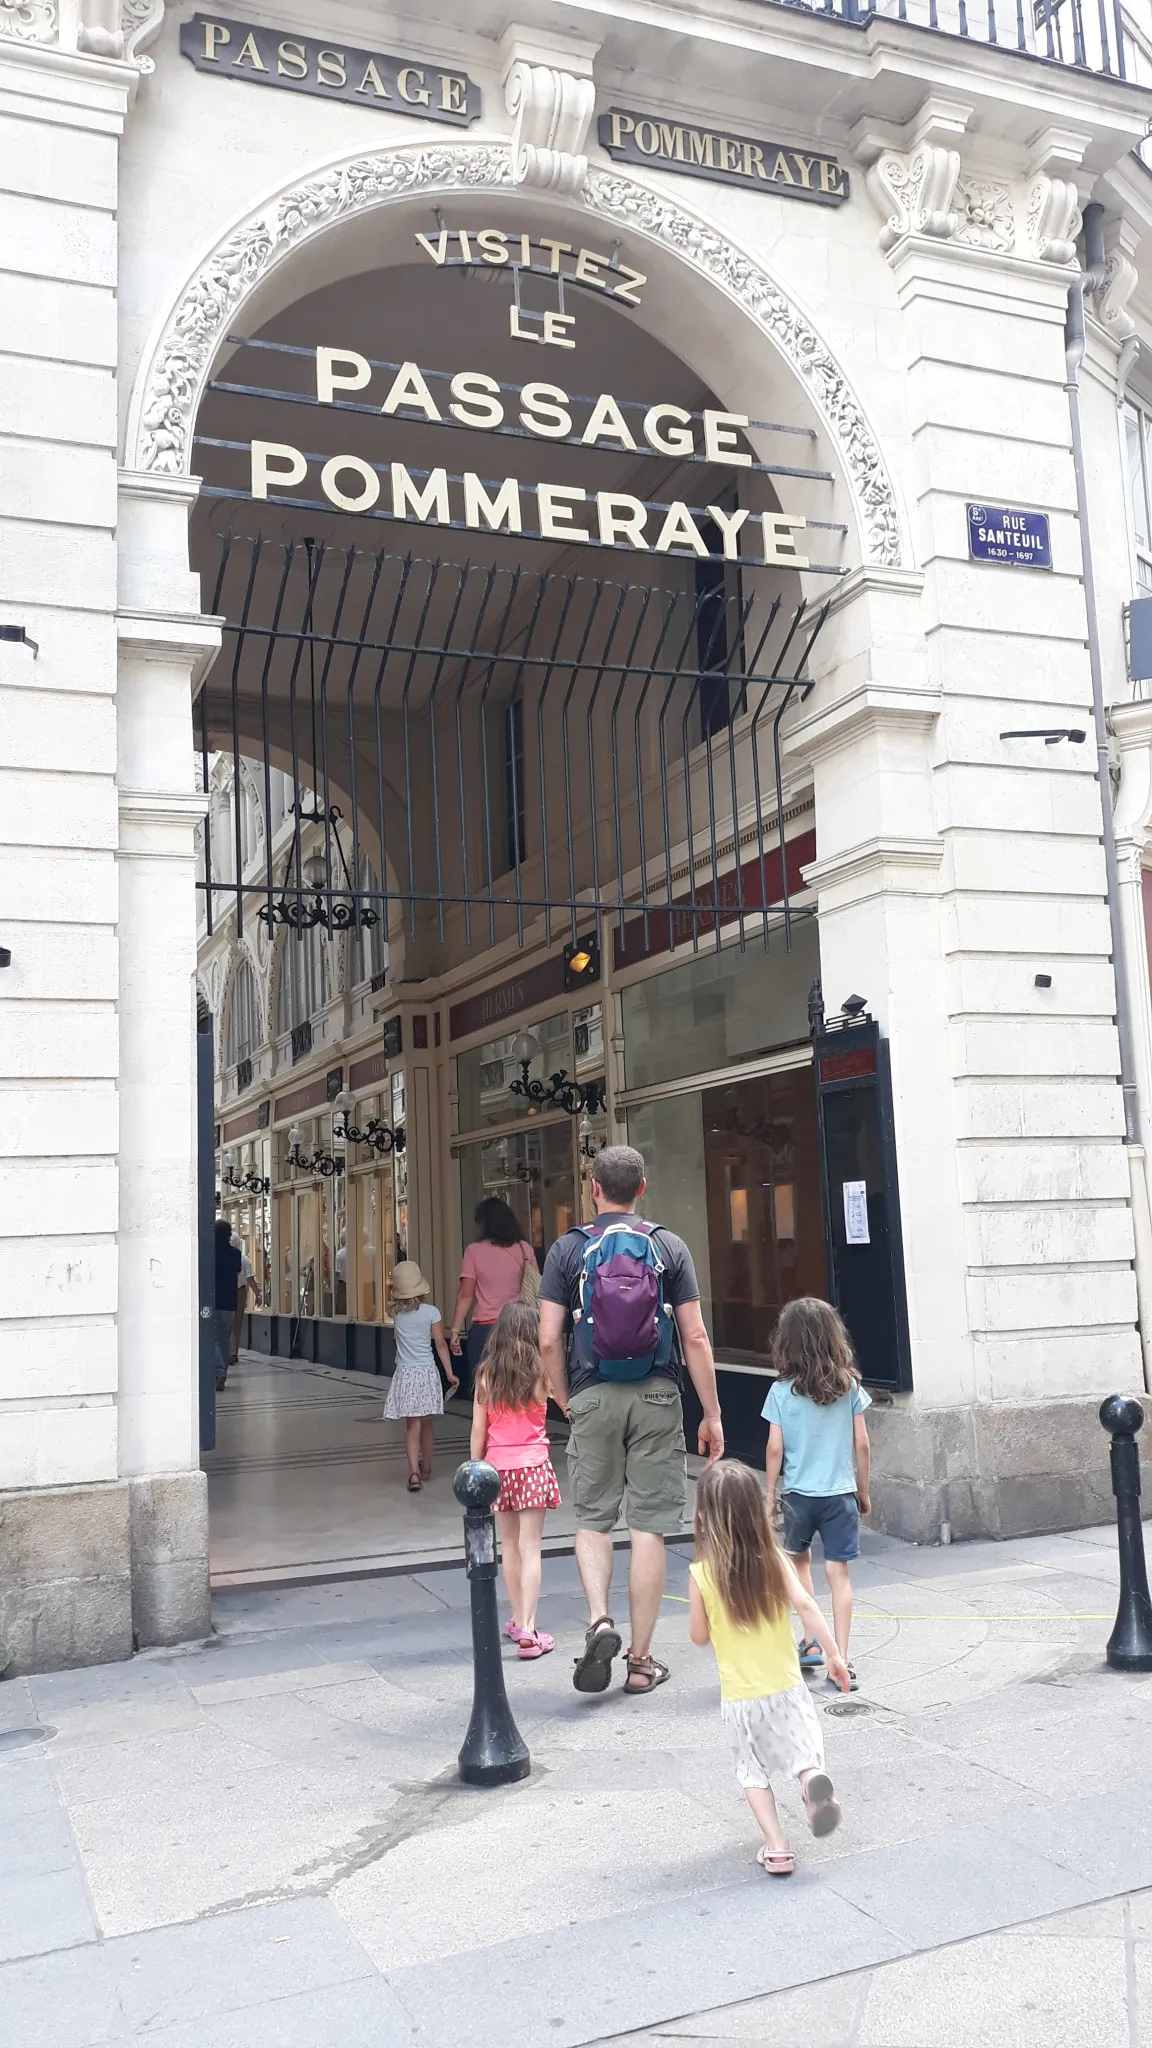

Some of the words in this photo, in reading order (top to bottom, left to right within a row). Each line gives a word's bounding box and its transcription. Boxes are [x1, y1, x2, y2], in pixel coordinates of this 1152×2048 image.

[200, 20, 469, 115] PASSAGE
[607, 111, 847, 197] POMMERAYE
[415, 227, 649, 306] VISITEZ
[508, 304, 576, 349] LE
[315, 345, 752, 467] PASSAGE
[250, 439, 810, 567] POMMERAYE
[1003, 516, 1026, 530] RUE
[978, 528, 1044, 550] SANTEUIL
[987, 547, 1007, 557] 1630
[1016, 551, 1034, 561] 1697
